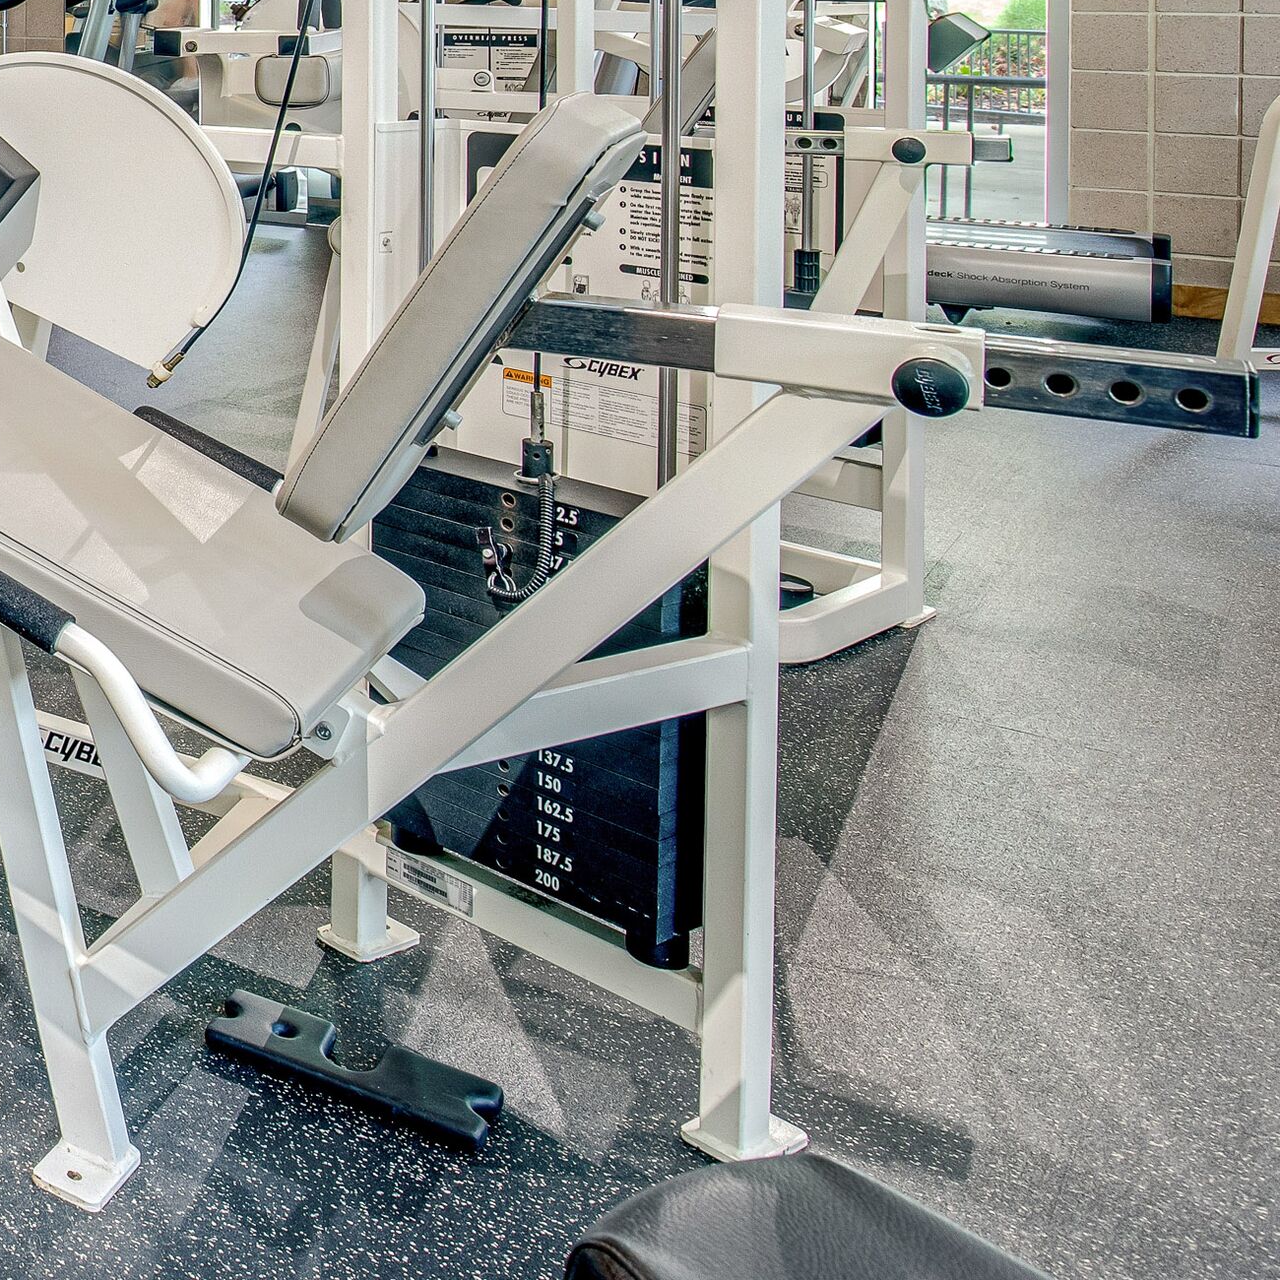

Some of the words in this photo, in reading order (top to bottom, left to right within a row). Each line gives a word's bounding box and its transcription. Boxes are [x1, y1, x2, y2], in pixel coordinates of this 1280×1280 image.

[636, 267, 661, 277] MUSCLE
[956, 271, 989, 282] Shock
[990, 276, 1048, 288] Absorption
[1049, 280, 1090, 292] System
[587, 359, 642, 380] CYBEX
[538, 749, 574, 773] 137.5
[537, 771, 561, 793] 150
[536, 796, 574, 823] 162.5
[536, 820, 561, 843] 175
[536, 844, 573, 872] 187.5
[534, 869, 560, 892] 200
